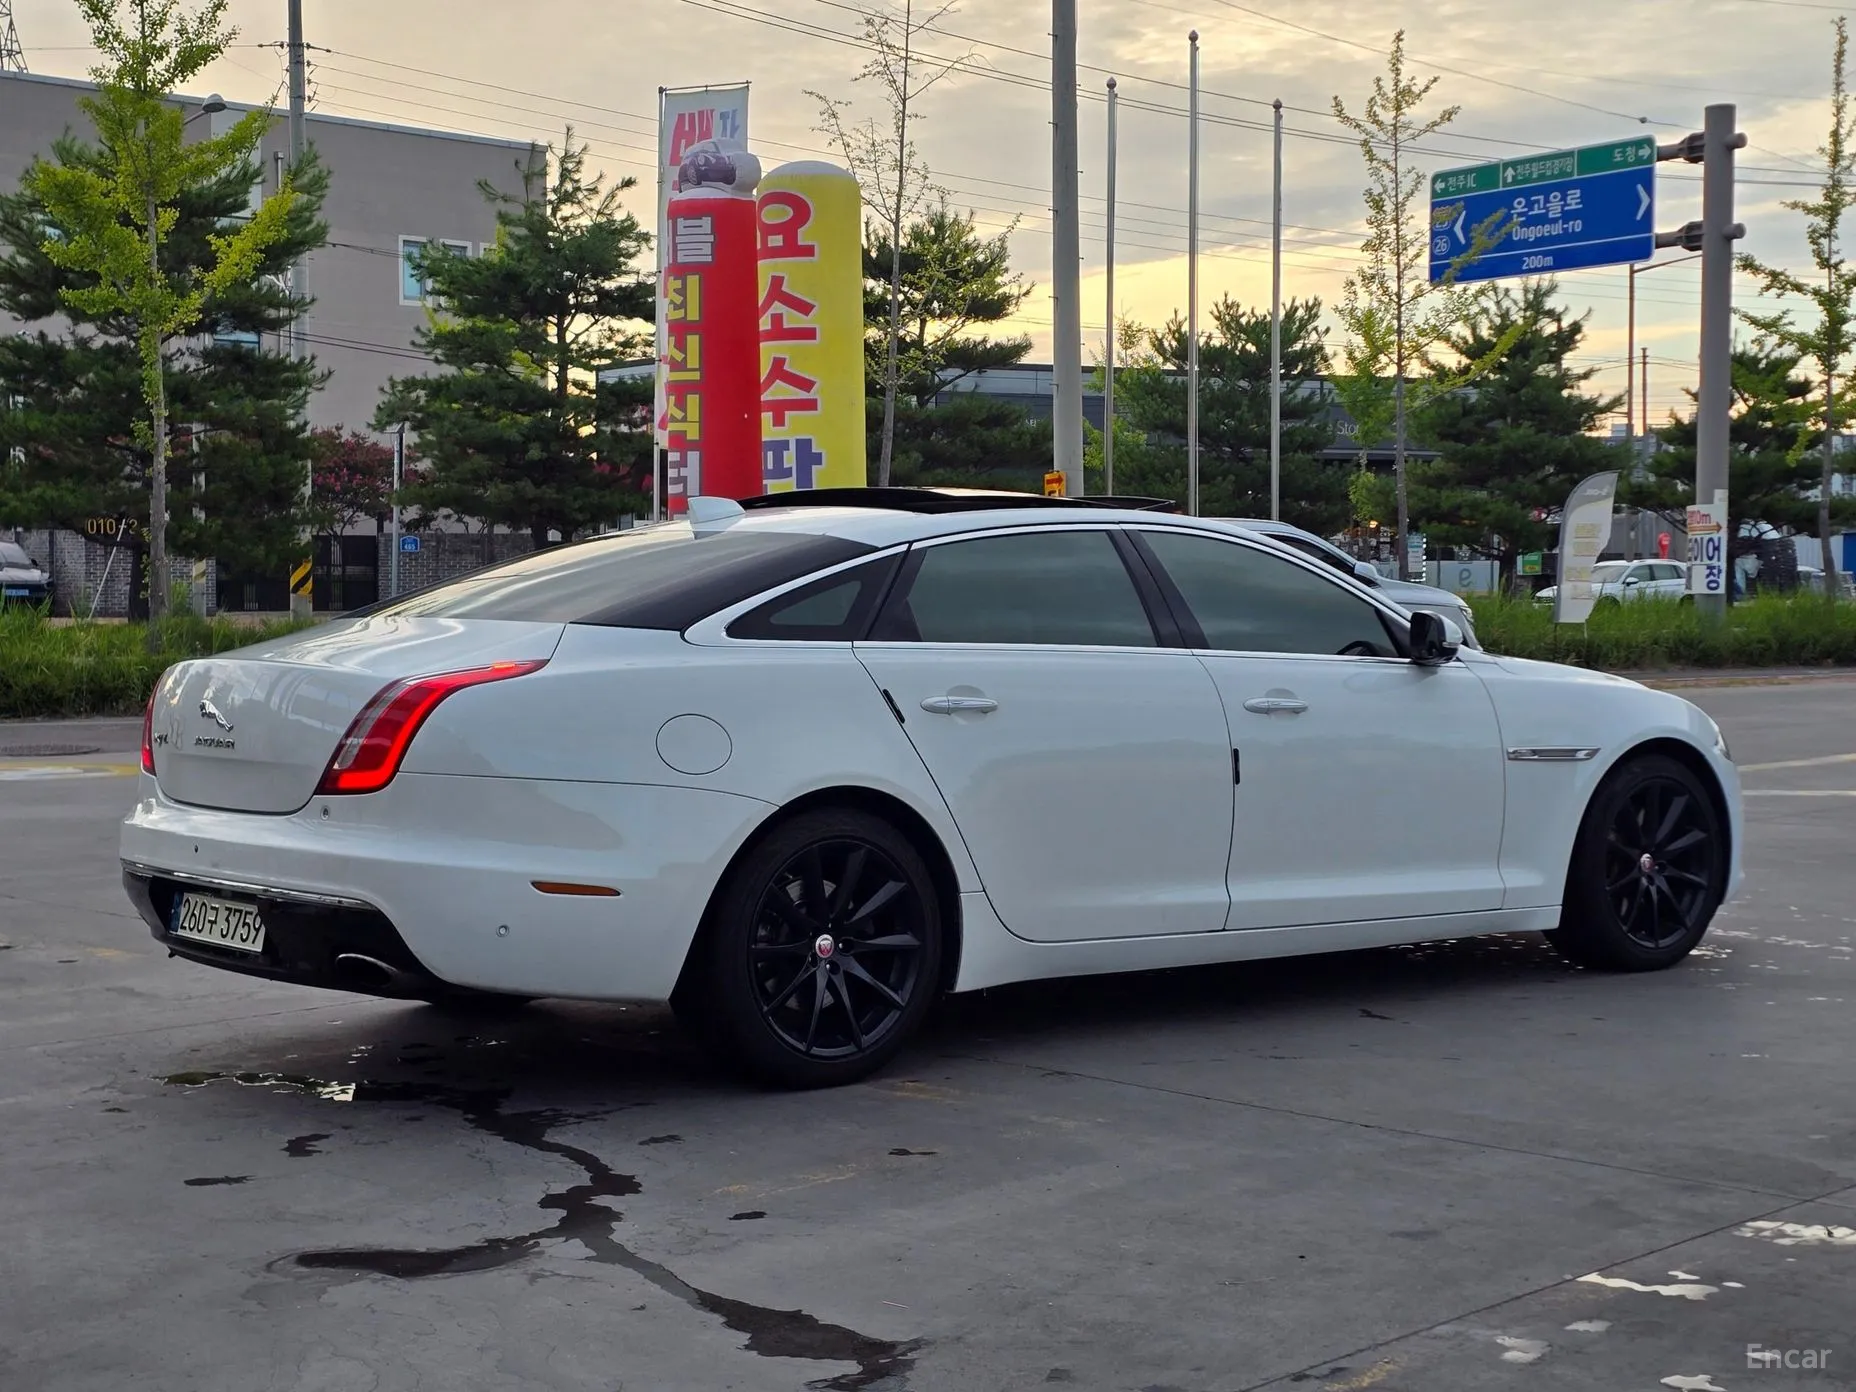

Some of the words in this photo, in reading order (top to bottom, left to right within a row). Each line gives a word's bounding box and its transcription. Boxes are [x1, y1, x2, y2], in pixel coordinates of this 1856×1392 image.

[1612, 145, 1636, 163] 도청
[1516, 156, 1574, 180] 전주월드컵경기장
[1447, 172, 1477, 191] 전주IC
[1510, 189, 1583, 222] 온고을로
[1512, 219, 1583, 241] Ongoeul-ro
[1435, 238, 1448, 252] 26
[1522, 255, 1554, 270] 200m
[757, 190, 817, 428] 요소수
[194, 735, 236, 750] JAGUAR
